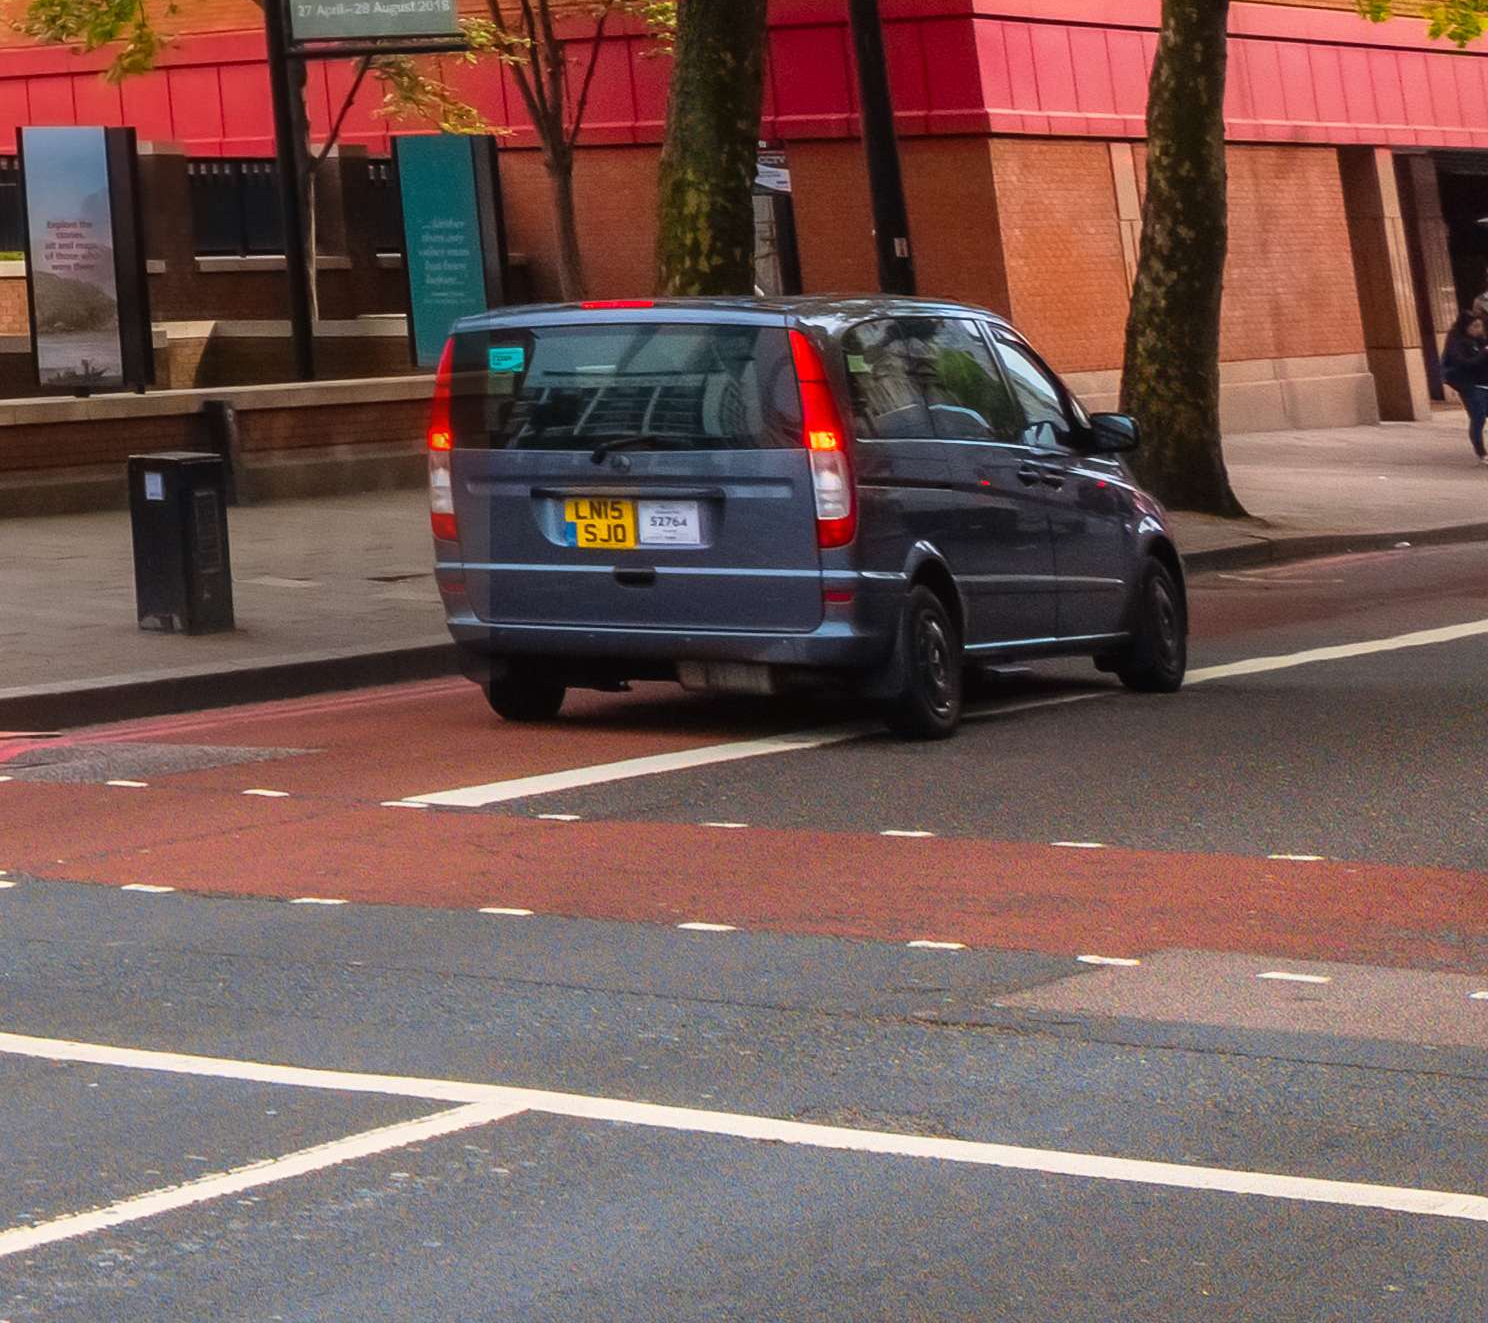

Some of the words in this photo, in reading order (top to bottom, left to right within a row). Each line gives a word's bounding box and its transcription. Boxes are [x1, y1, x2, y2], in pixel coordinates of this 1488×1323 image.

[297, 4, 312, 17] 27
[373, 0, 416, 17] August
[574, 500, 624, 520] LN15
[584, 523, 627, 543] SJO
